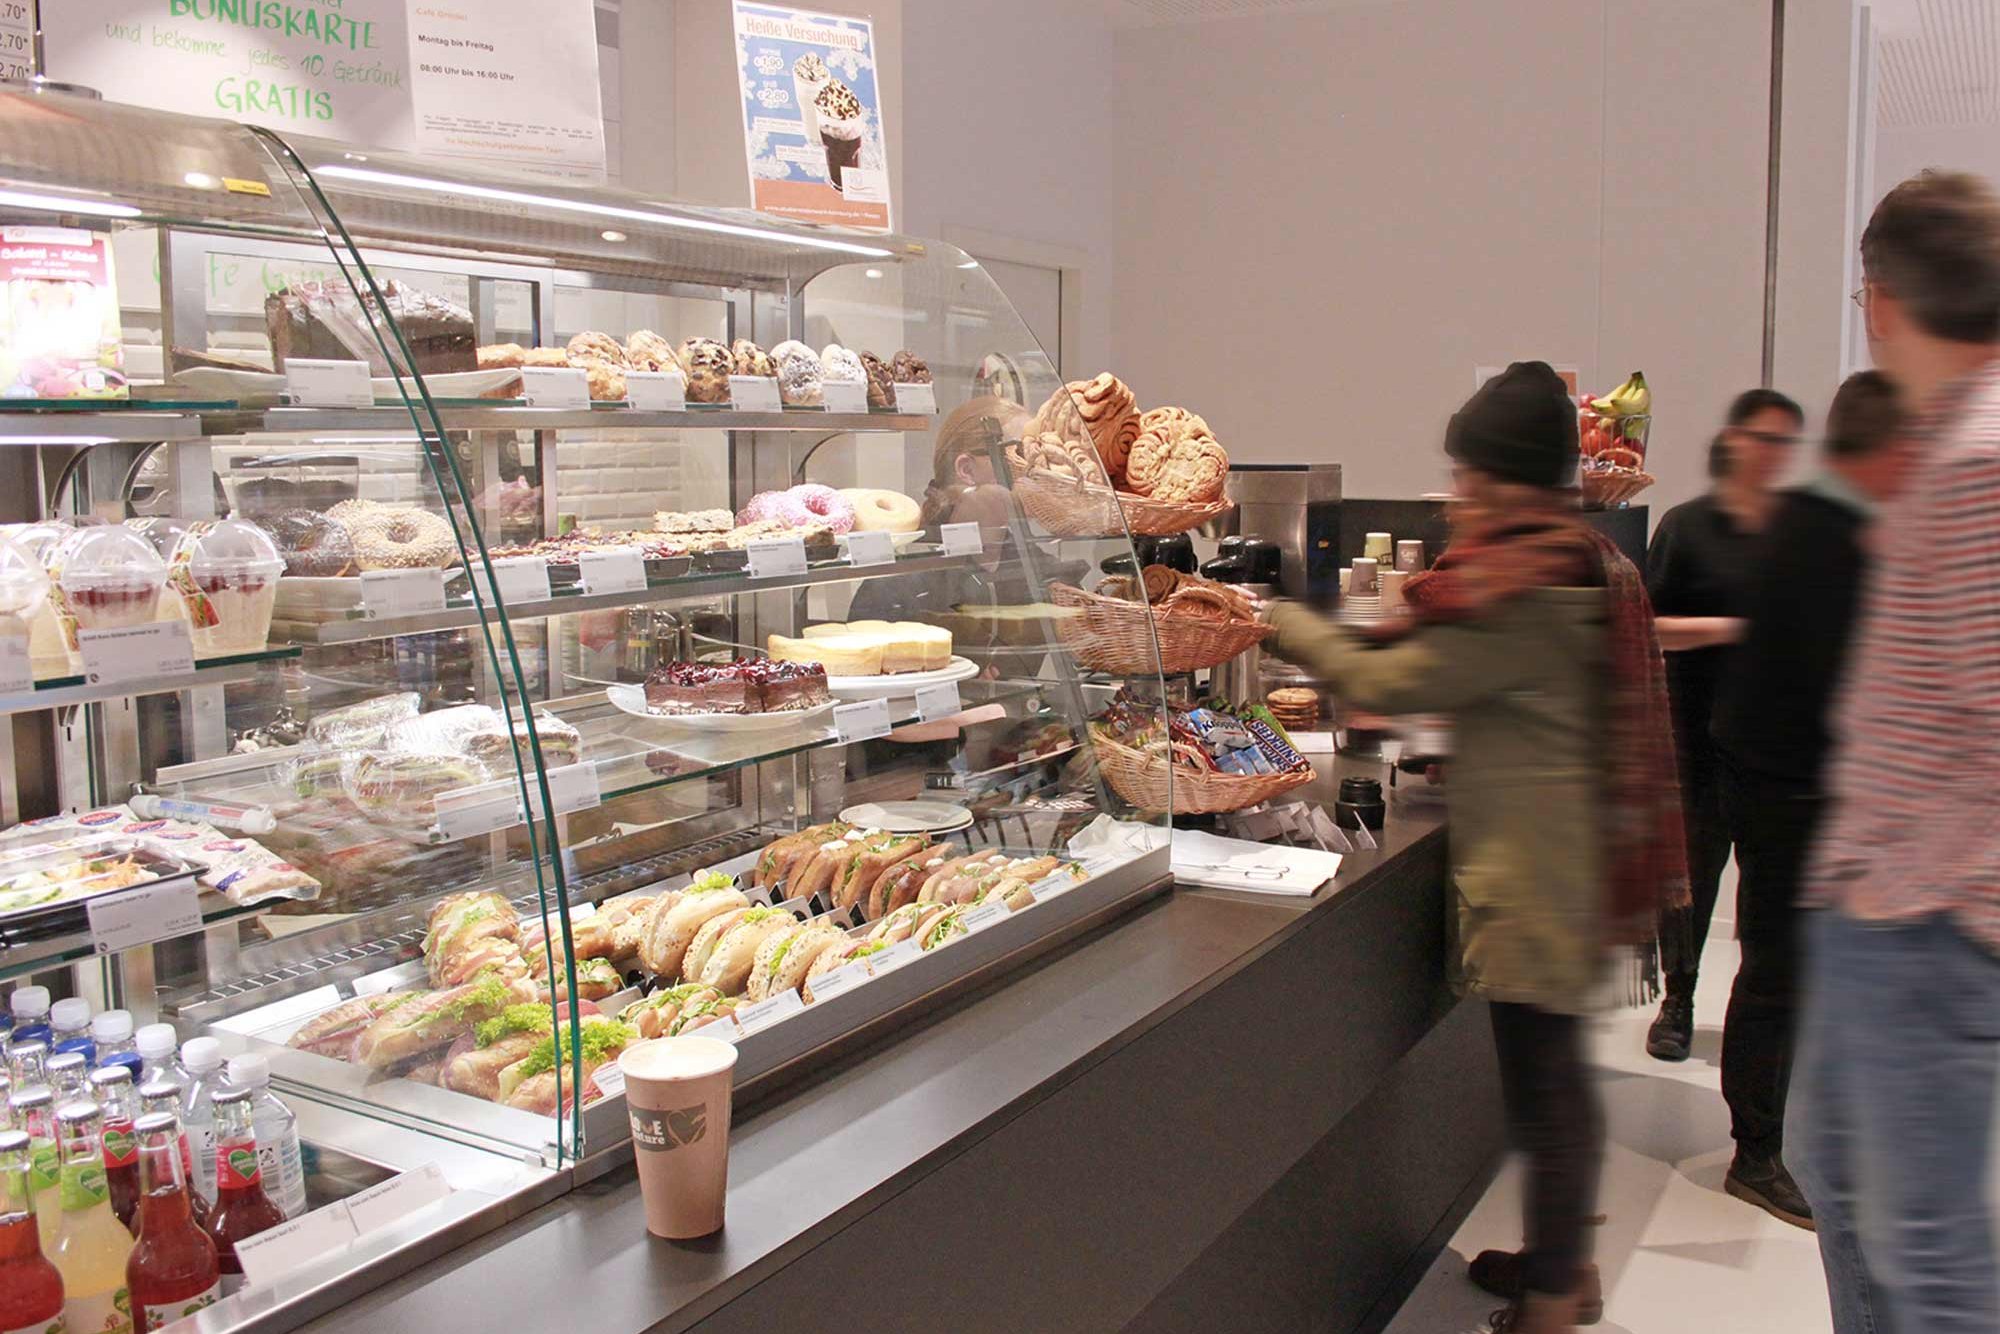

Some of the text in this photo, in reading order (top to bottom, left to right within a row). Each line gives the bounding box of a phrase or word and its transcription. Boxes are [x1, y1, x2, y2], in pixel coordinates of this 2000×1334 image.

[105, 23, 142, 44] und
[152, 26, 225, 57] bekomme
[170, 0, 379, 50] BONUSKARTE
[746, 18, 859, 49] Heiße Versuchung
[418, 35, 495, 52] Montag bis Freitag
[444, 66, 460, 75] Uhr
[461, 69, 474, 77] bis
[499, 73, 515, 81] Uhr
[215, 76, 334, 121] GRATIS
[1251, 720, 1302, 765] SNICKERS
